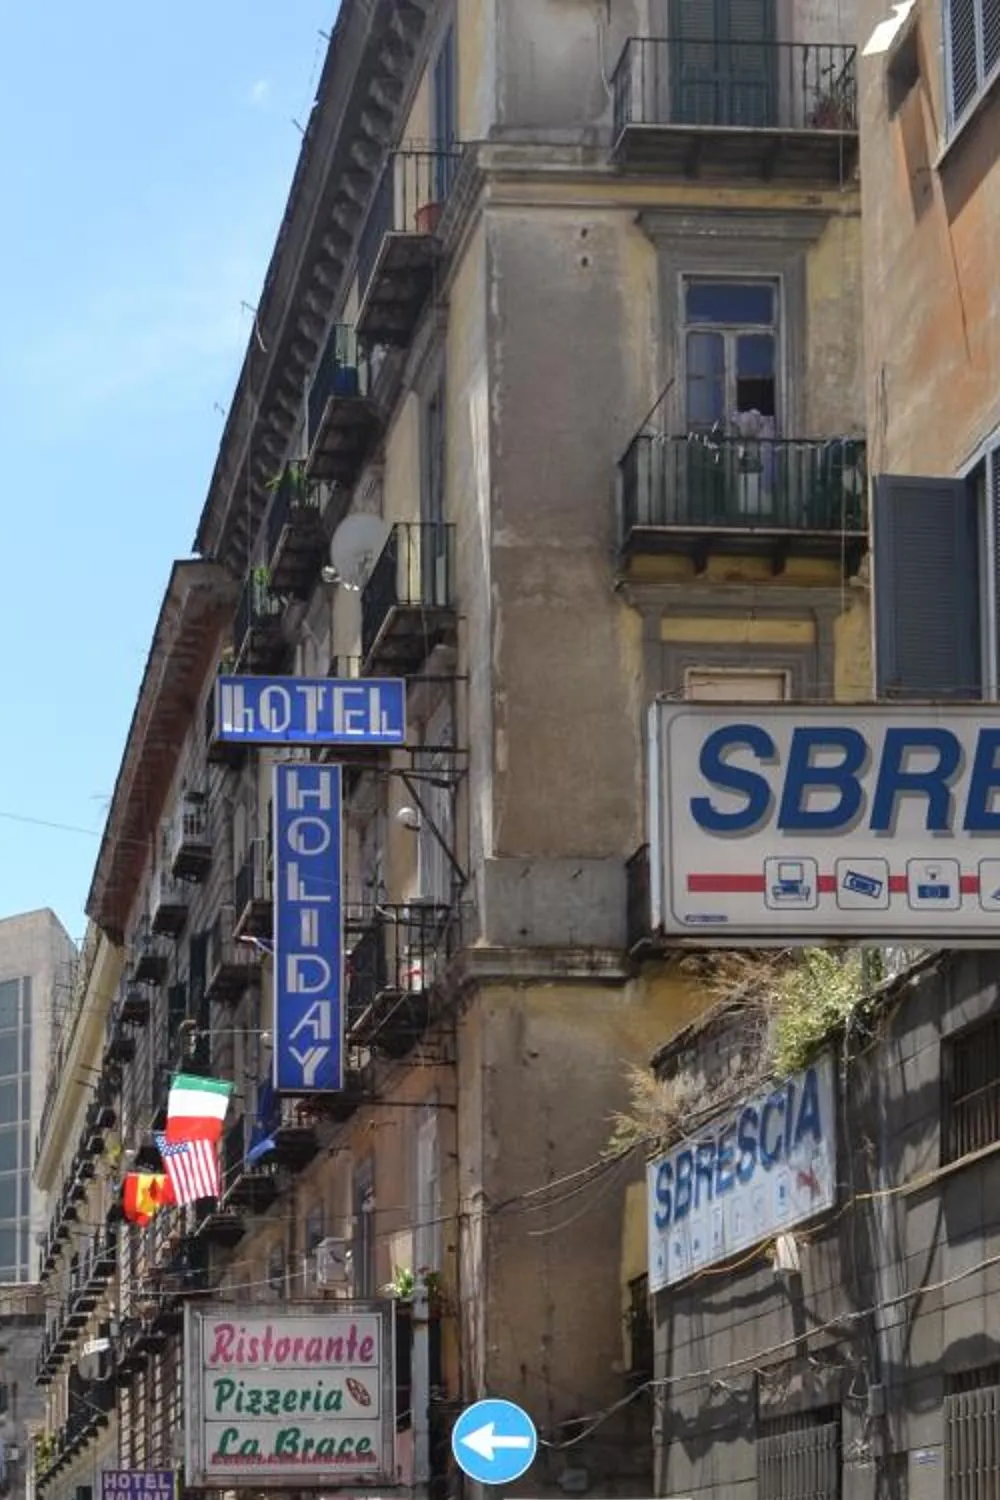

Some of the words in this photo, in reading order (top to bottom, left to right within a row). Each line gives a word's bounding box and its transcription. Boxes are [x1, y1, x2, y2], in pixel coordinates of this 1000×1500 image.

[286, 770, 332, 1087] HOLIDAY
[654, 1067, 822, 1231] SBRESCIA
[209, 1322, 375, 1364] Ristorante
[213, 1376, 343, 1416] Pizzeria
[216, 1427, 260, 1458] La
[275, 1427, 372, 1459] Brace
[103, 1472, 171, 1490] HOTEL
